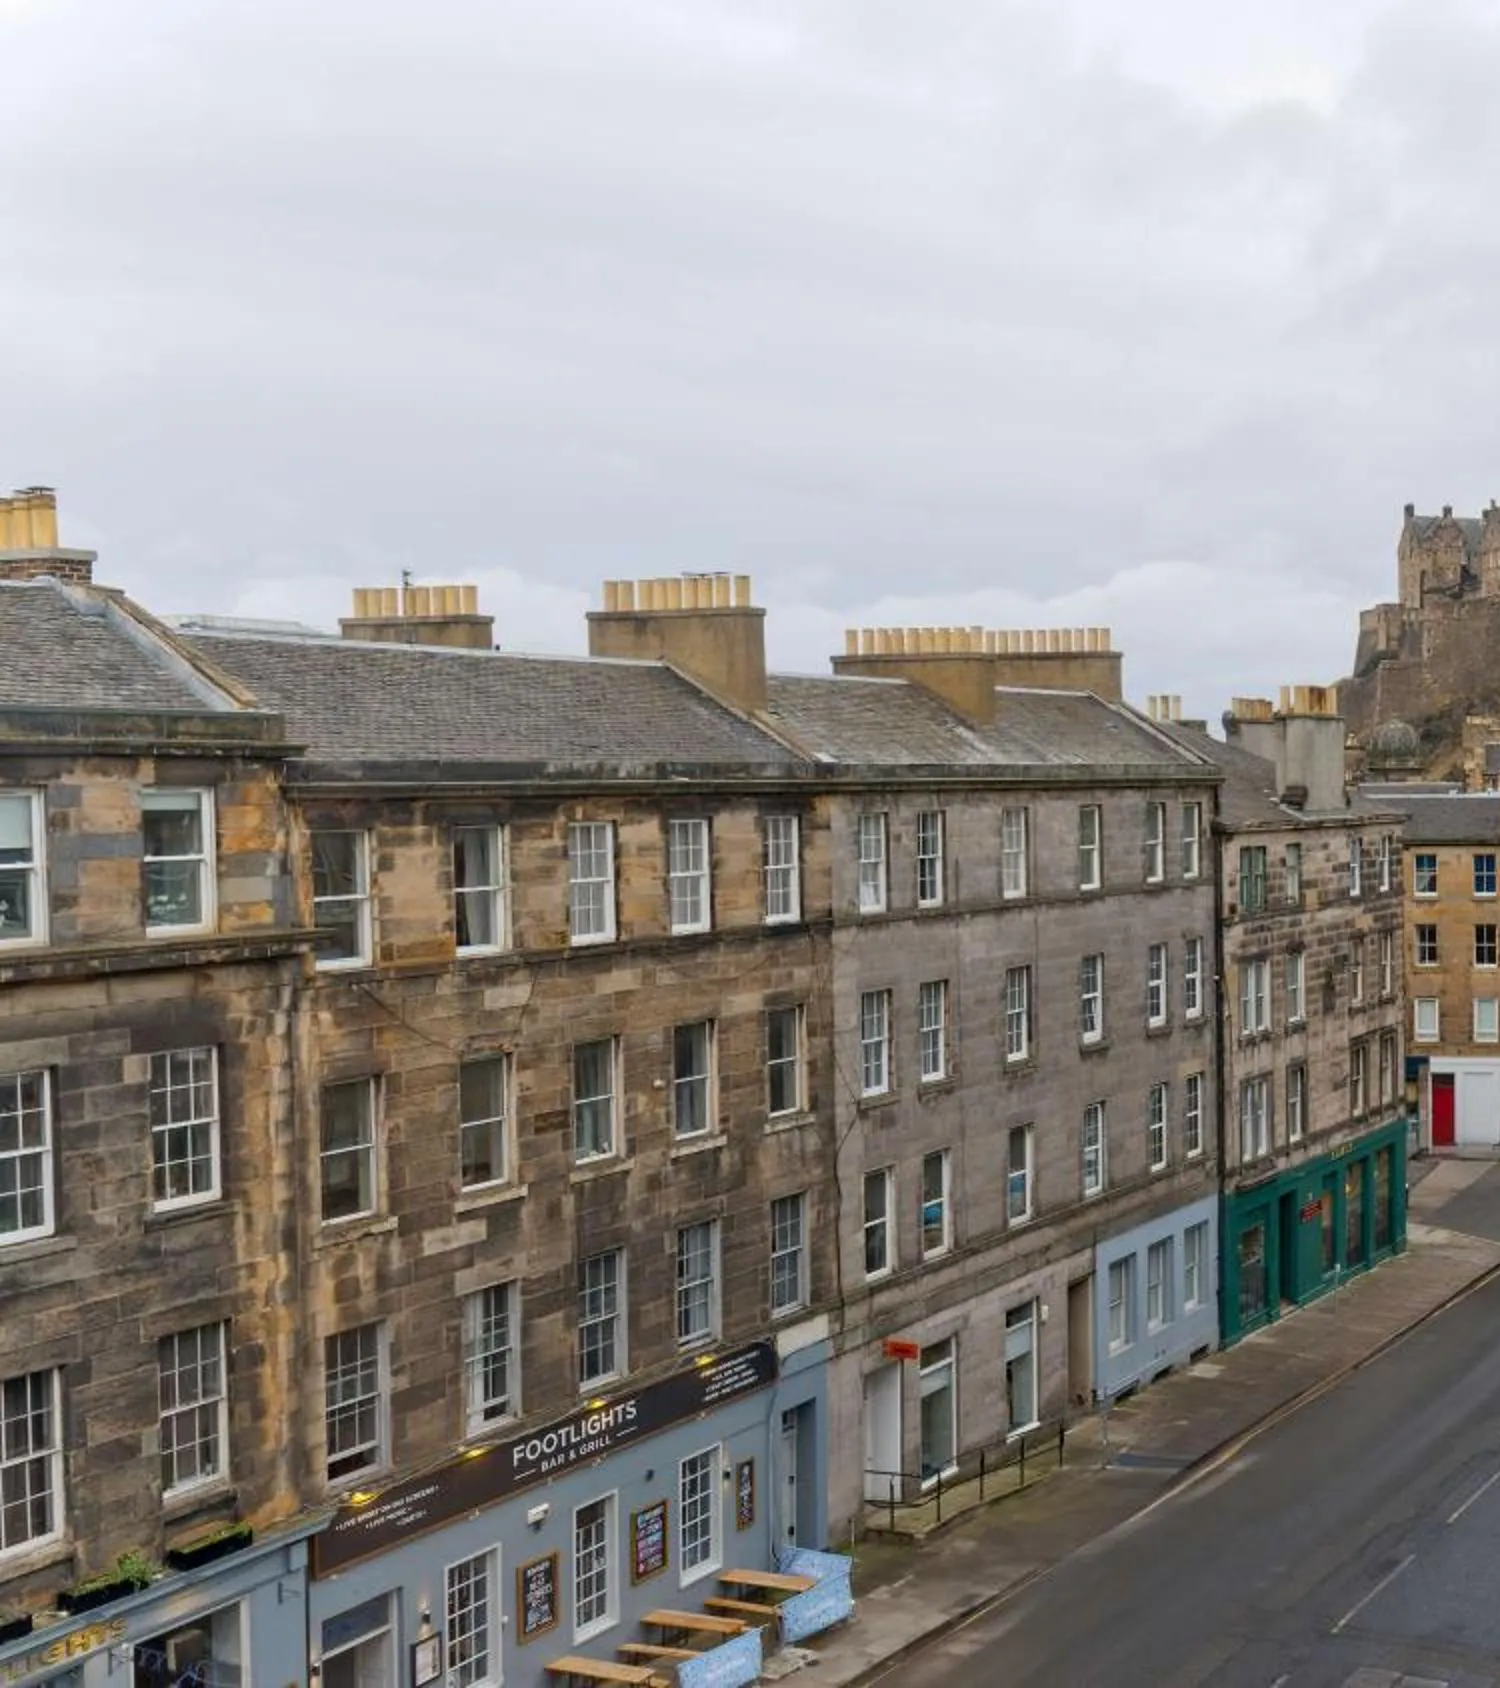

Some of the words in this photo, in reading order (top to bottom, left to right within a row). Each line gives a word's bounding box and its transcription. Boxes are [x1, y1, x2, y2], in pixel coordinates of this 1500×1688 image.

[513, 1400, 637, 1468] FOOTLIGHTS
[541, 1454, 565, 1472] BAR
[569, 1450, 577, 1461] &
[580, 1435, 611, 1455] GRILL
